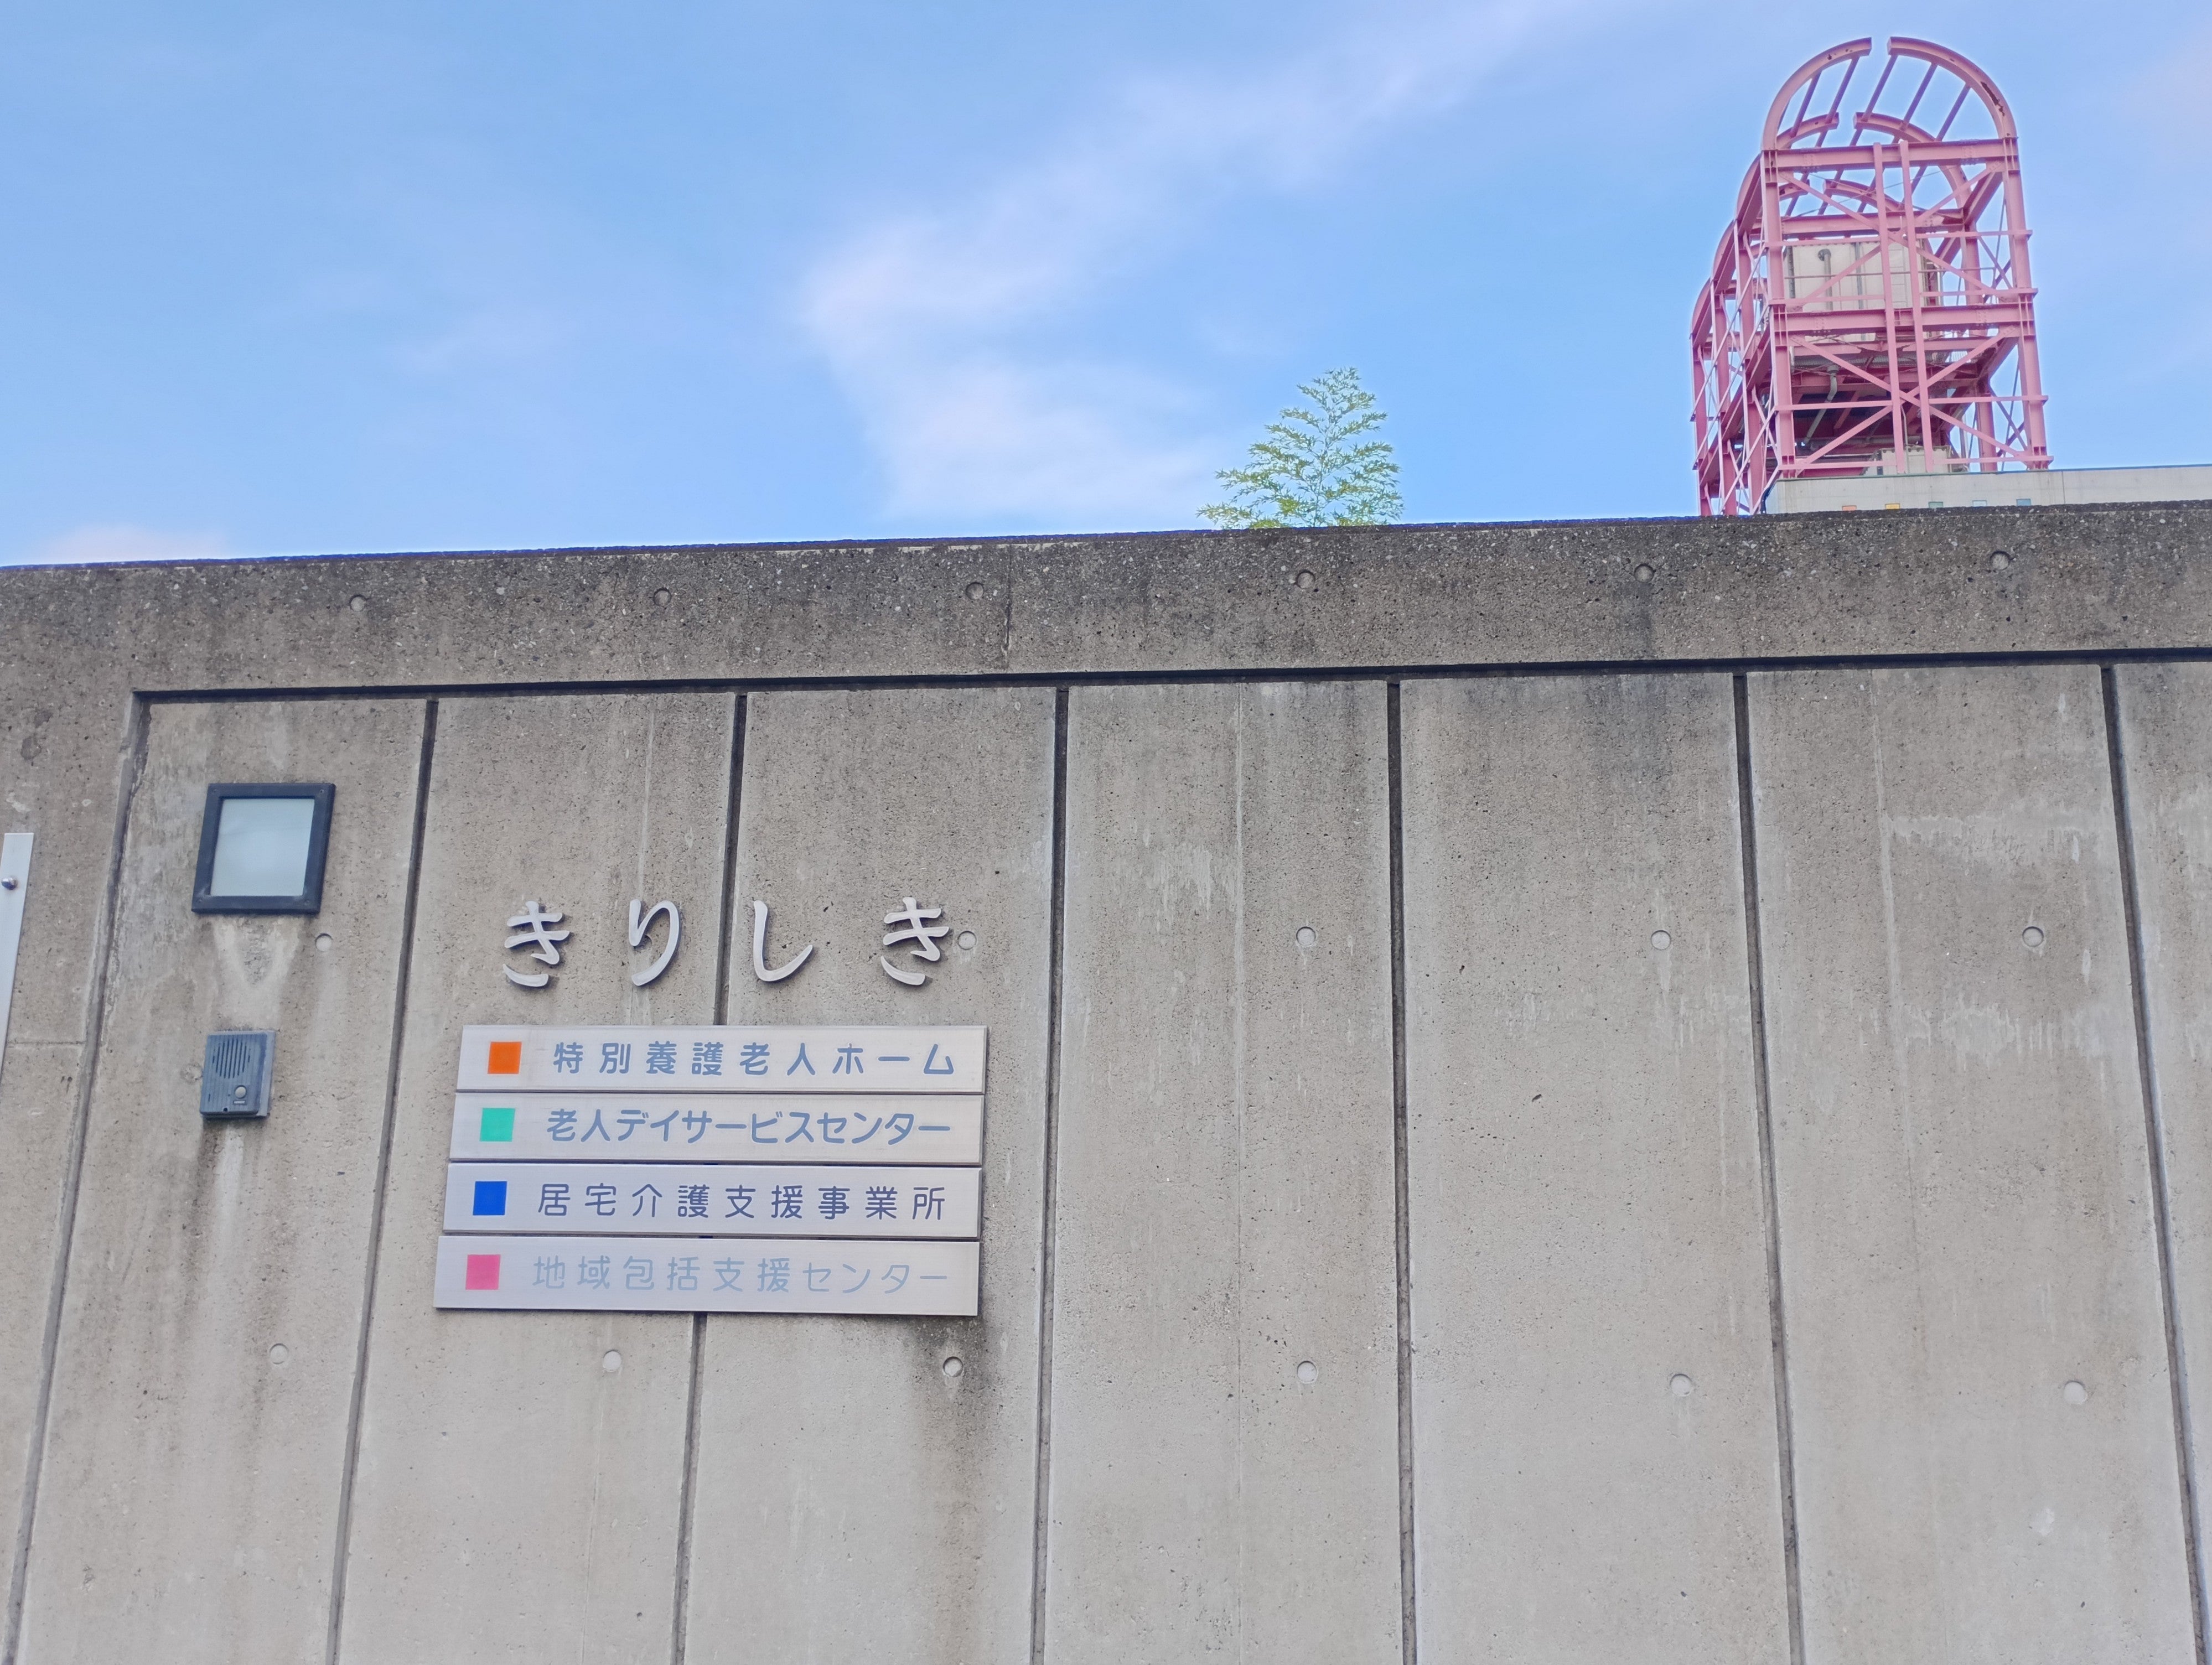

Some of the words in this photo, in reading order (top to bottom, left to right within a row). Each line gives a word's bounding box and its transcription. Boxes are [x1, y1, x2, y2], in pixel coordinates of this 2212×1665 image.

[504, 897, 950, 987] きりしき
[553, 1041, 954, 1076] 特別養護老人ホーム
[547, 1109, 950, 1145] 老人デイサービスセンター
[538, 1183, 945, 1220] 居宅介護支援事業所
[532, 1256, 947, 1293] 地域包括支援センター
